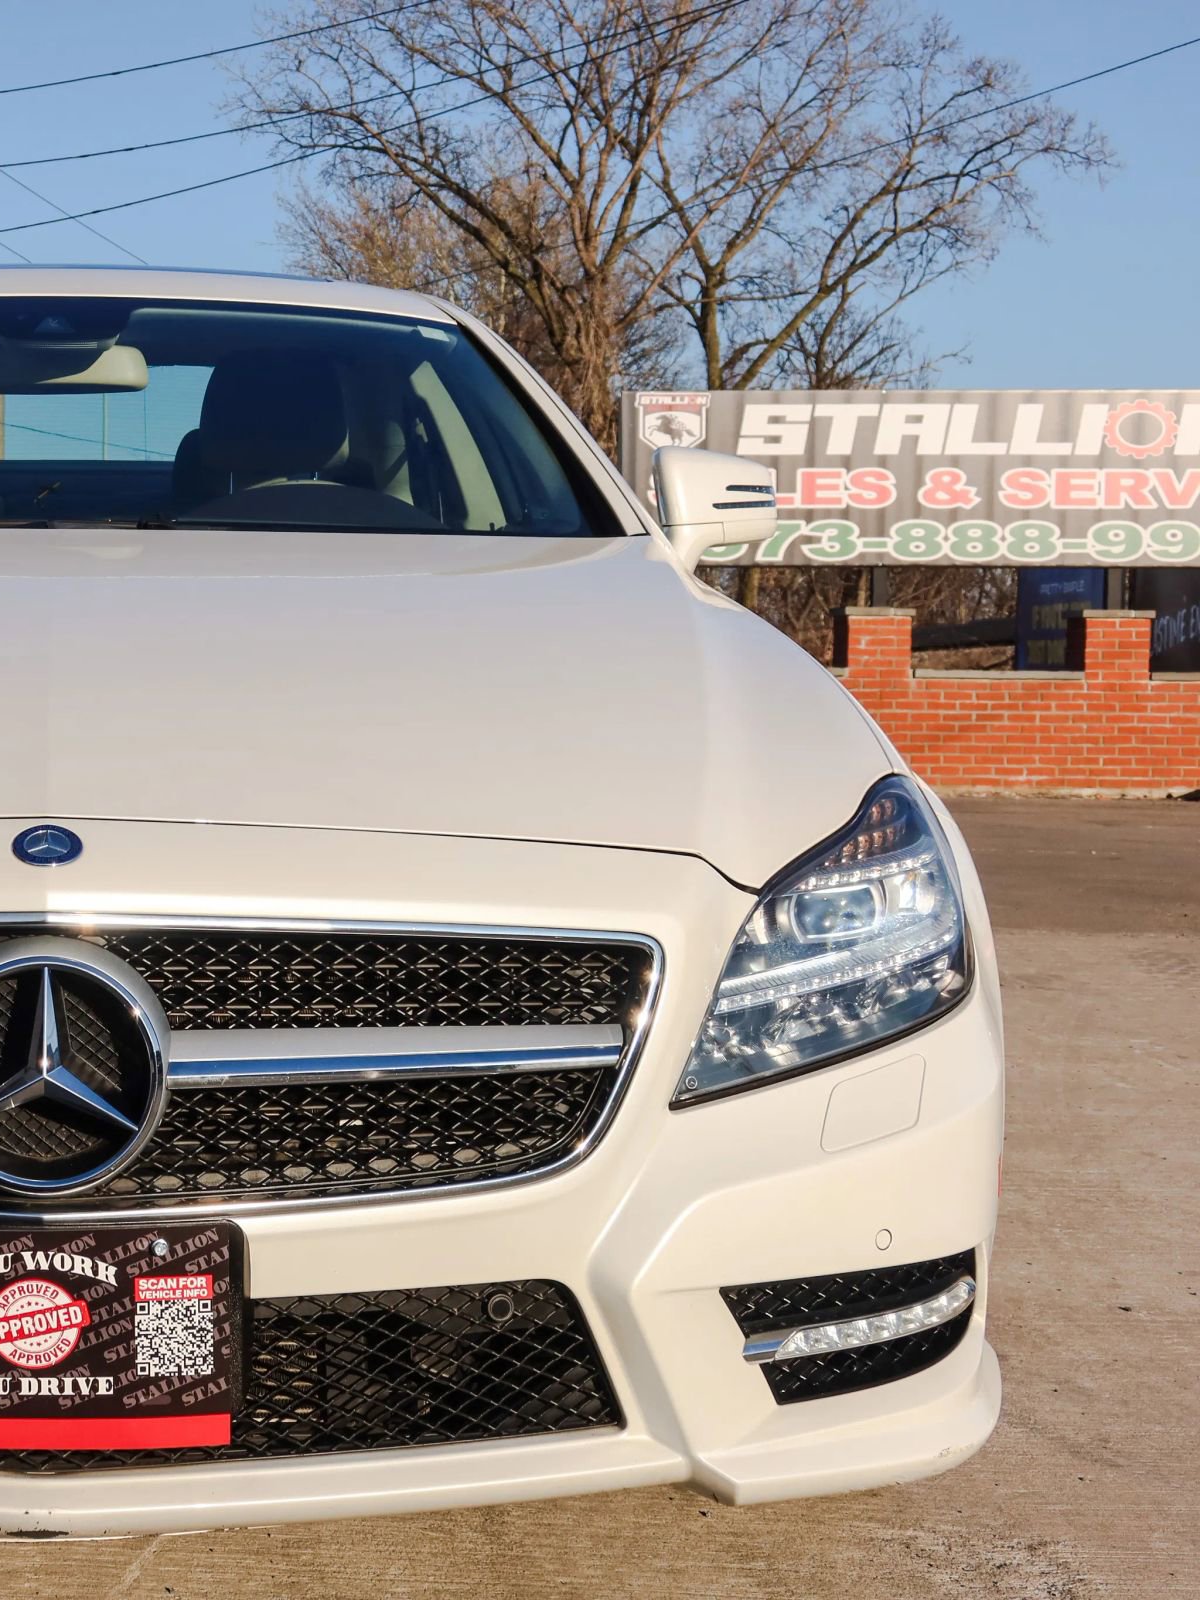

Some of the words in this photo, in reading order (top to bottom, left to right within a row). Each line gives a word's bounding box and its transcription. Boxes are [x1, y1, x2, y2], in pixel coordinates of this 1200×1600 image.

[917, 467, 981, 510] &
[999, 467, 1200, 510] SERV
[21, 1251, 119, 1287] WORK
[138, 1278, 179, 1290] SCAN
[179, 1277, 207, 1289] FOR
[139, 1289, 183, 1299] VEHICLE
[183, 1288, 208, 1298] INFO
[9, 1337, 71, 1365] APPROVED
[17, 1376, 114, 1396] DRIVE
